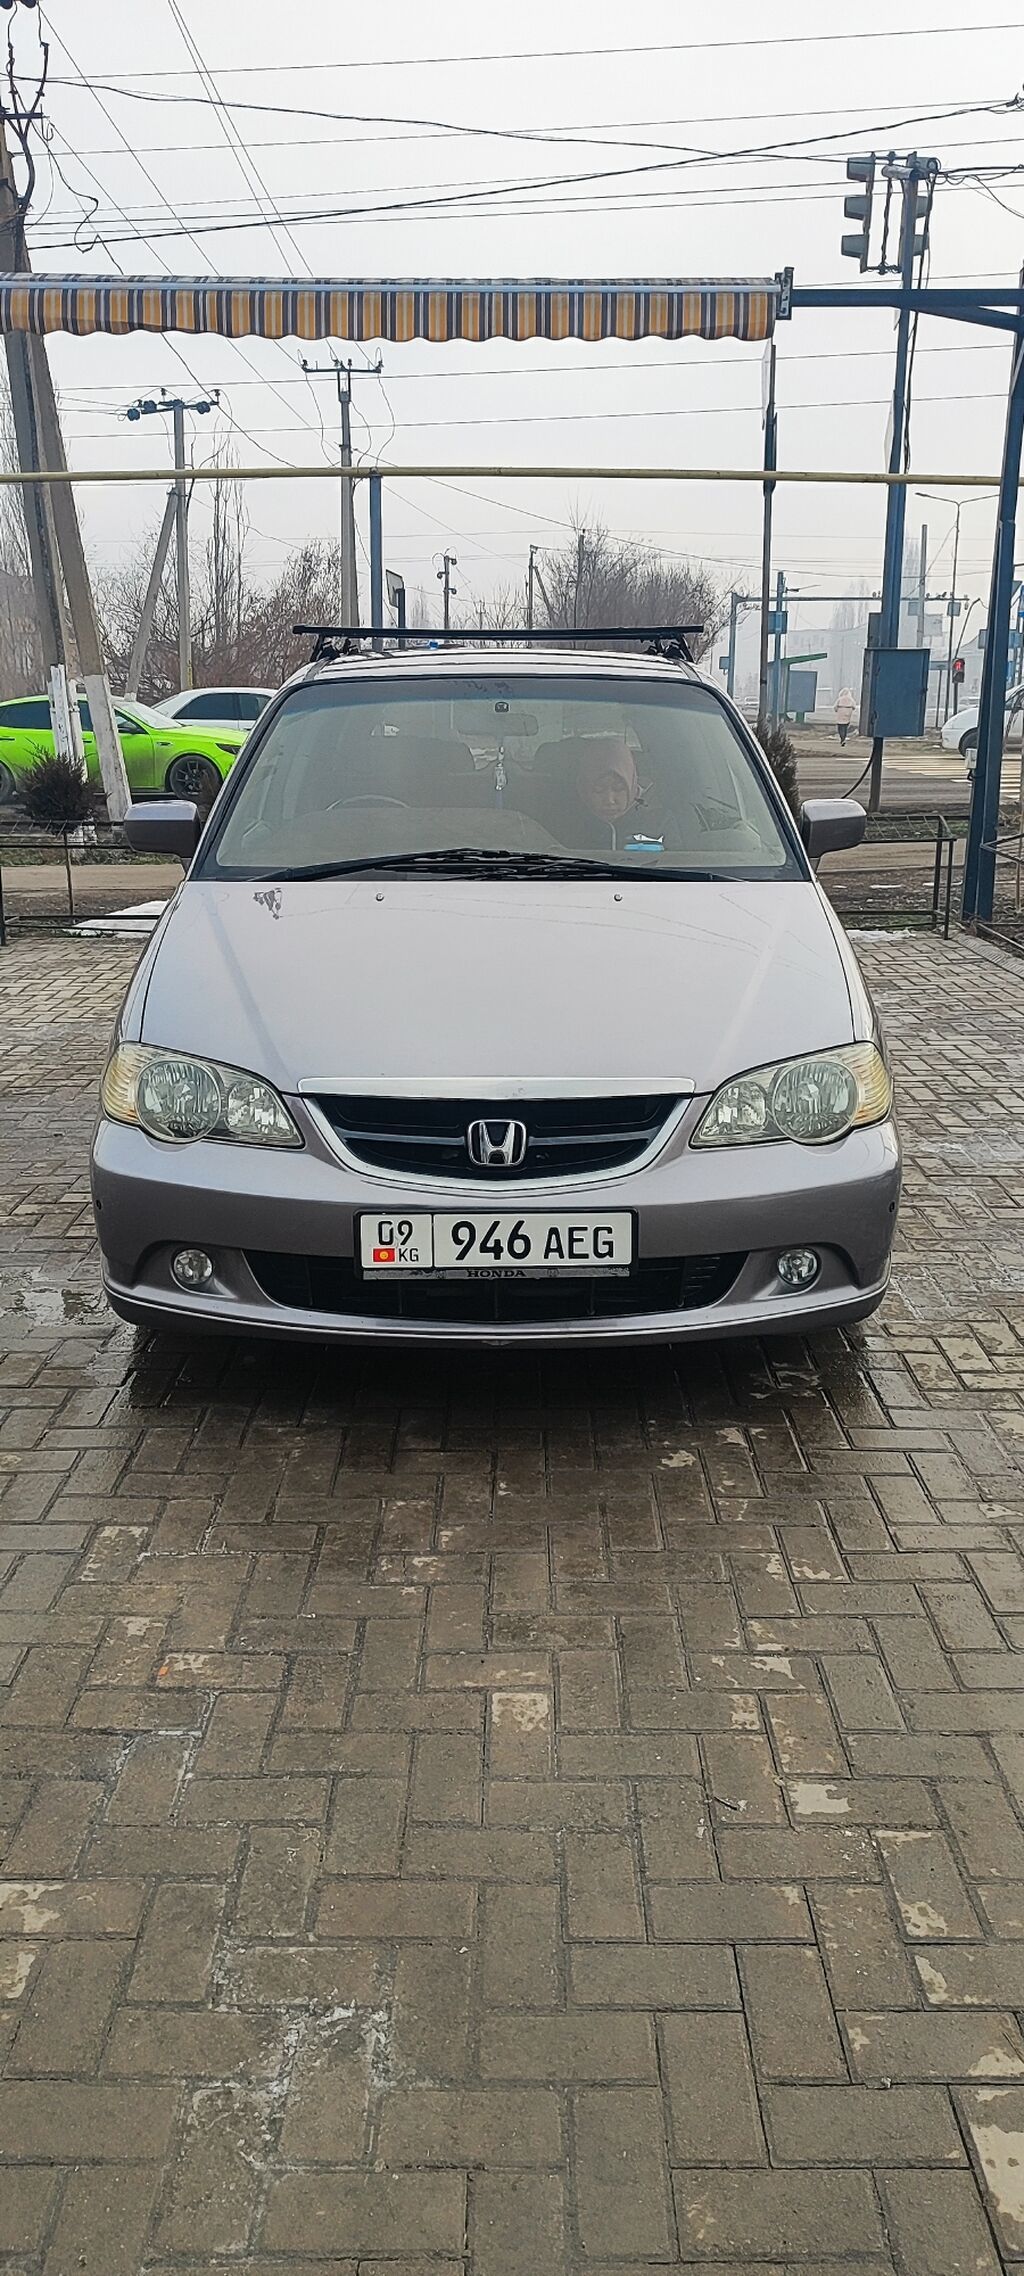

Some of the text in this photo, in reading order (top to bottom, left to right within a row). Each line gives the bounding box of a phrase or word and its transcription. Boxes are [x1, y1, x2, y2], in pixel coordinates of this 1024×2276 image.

[377, 1220, 413, 1246] 09
[451, 1220, 615, 1261] 946 AEG
[398, 1248, 419, 1262] KG
[467, 1269, 526, 1278] HONDA
